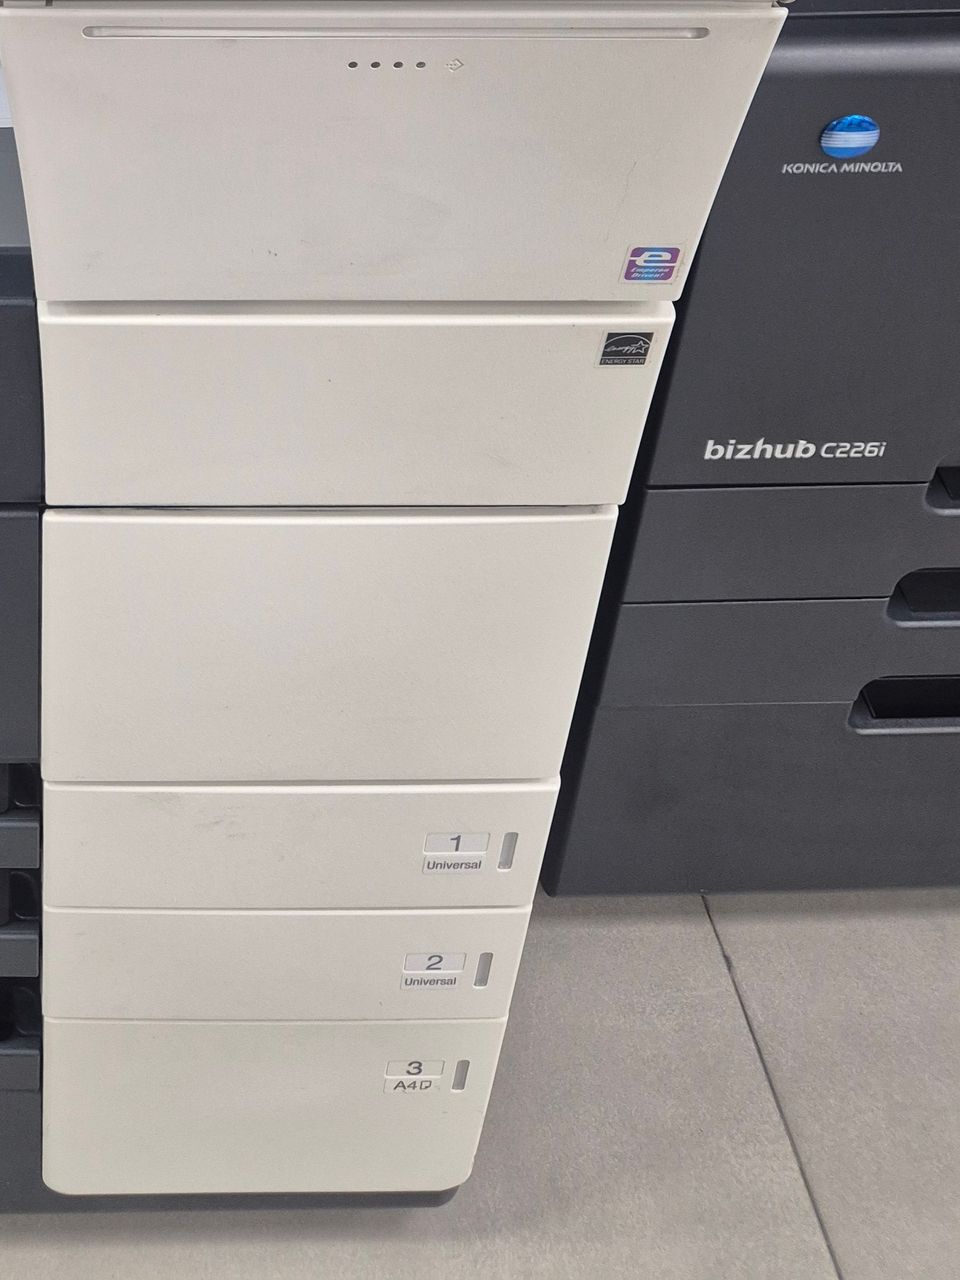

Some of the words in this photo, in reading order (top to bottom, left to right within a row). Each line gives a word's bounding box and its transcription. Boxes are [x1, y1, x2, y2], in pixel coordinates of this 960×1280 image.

[782, 162, 838, 174] KONICA
[840, 161, 903, 173] MINOLTA
[704, 437, 817, 460] bizhub
[820, 442, 887, 458] C226i
[450, 835, 462, 852] 1
[426, 860, 482, 870] Universal
[425, 955, 443, 971] 2
[404, 977, 457, 987] Universal
[406, 1061, 423, 1076] 3
